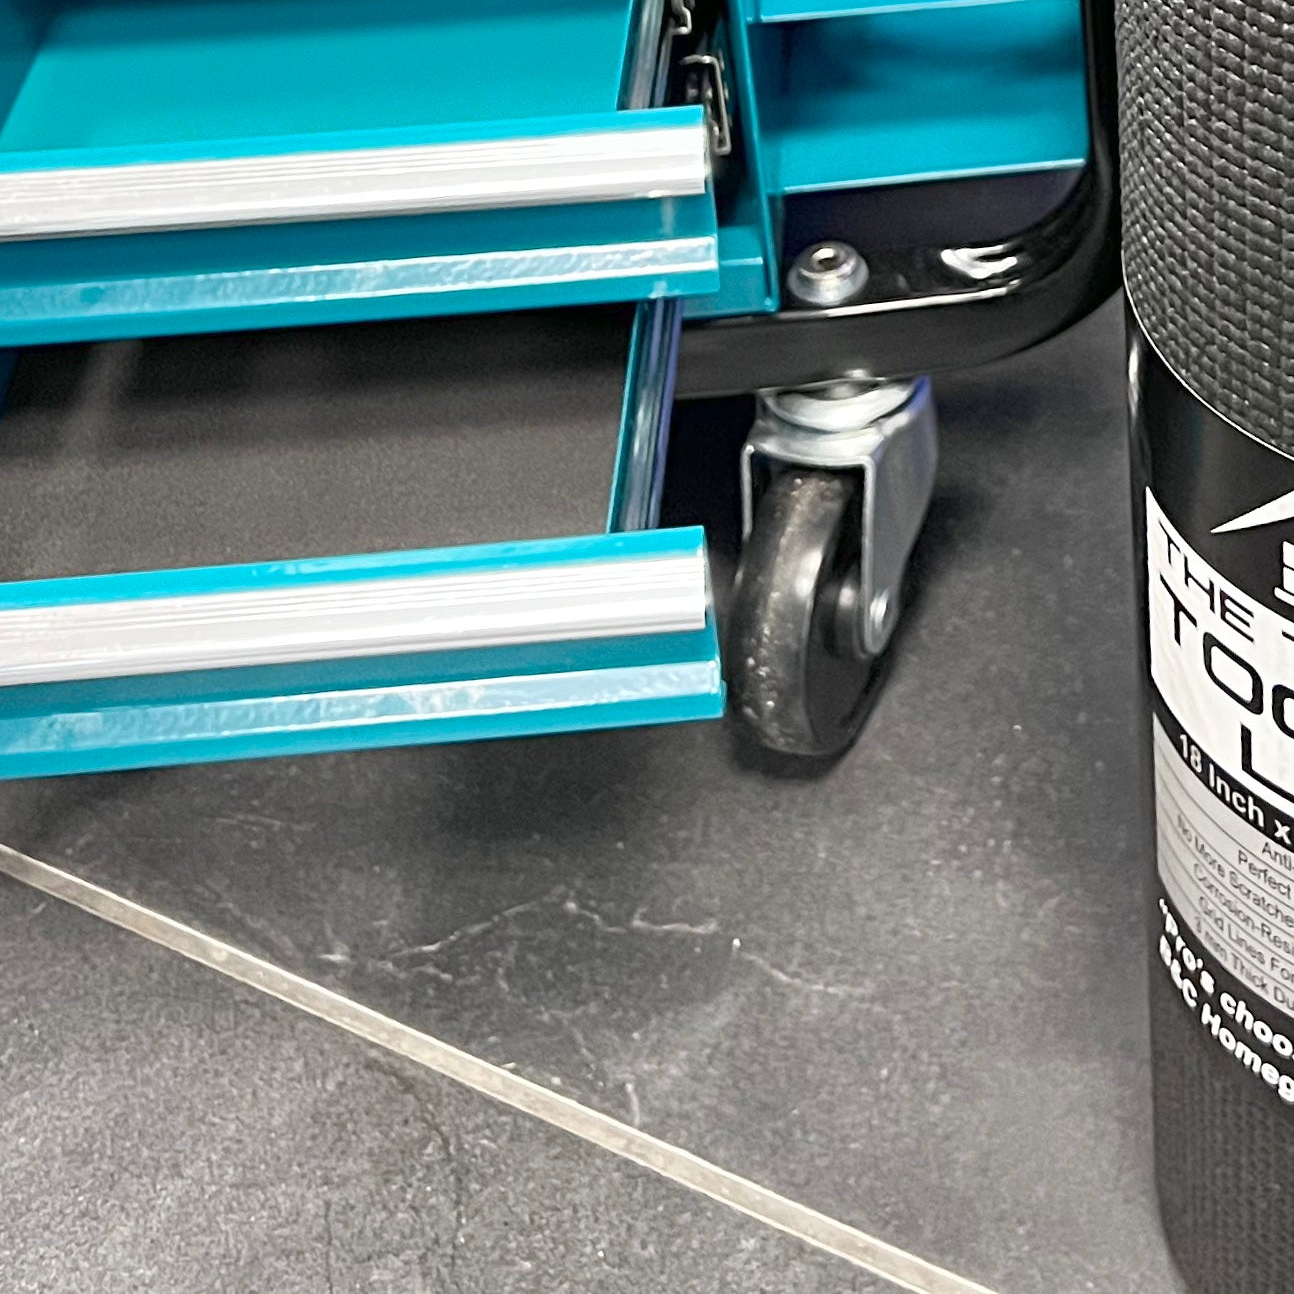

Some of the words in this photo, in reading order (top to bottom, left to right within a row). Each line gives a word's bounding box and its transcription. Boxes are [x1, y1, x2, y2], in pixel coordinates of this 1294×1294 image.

[1158, 519, 1254, 643] THE
[1179, 734, 1202, 773] 18
[1209, 763, 1265, 828] Inch
[1274, 818, 1292, 845] x
[1238, 849, 1292, 900] Perfect
[1227, 922, 1266, 966] Lines
[1231, 952, 1269, 995] Thick
